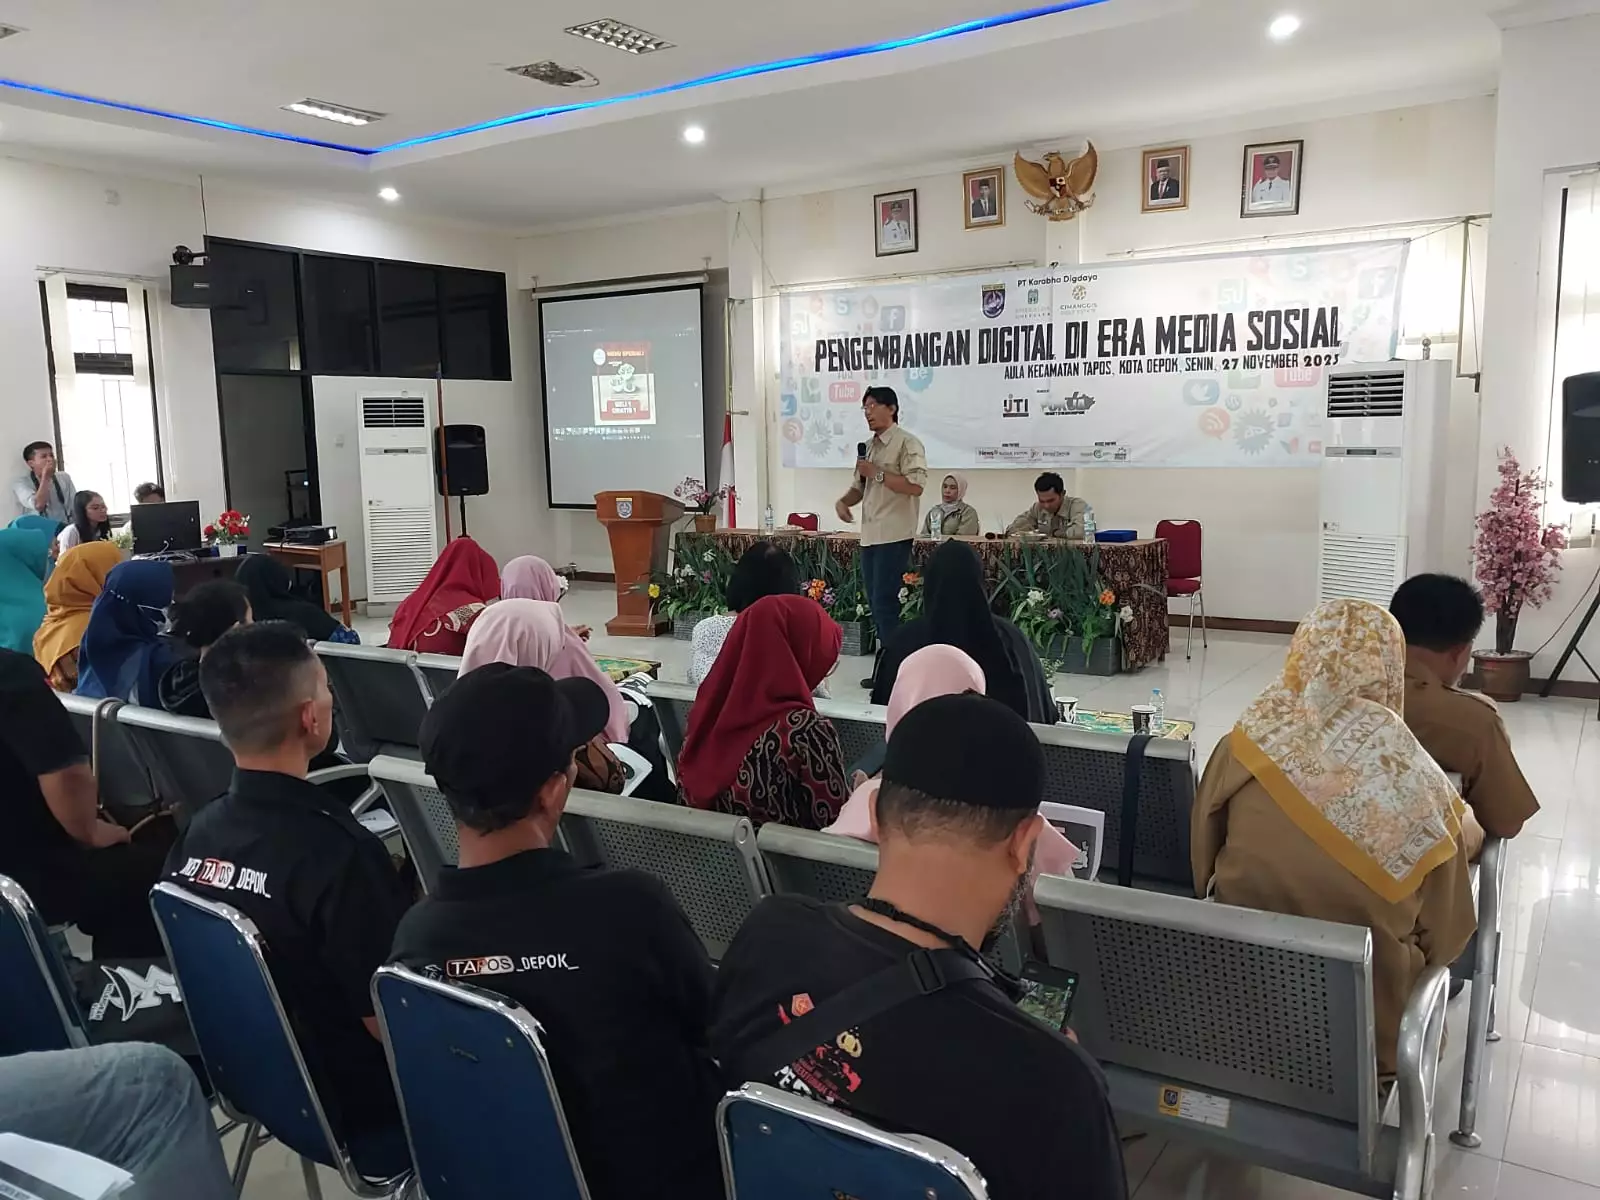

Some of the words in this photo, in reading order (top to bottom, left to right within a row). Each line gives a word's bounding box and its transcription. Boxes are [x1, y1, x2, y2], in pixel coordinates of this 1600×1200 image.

[1029, 277, 1061, 287] Karabha
[1063, 273, 1098, 284] Digdaya
[815, 329, 970, 373] PENGEMBANGAN
[977, 322, 1056, 364] DIGITAL
[1065, 321, 1089, 359] DI
[1097, 318, 1146, 358] ERA
[1155, 313, 1237, 355] MEDIA
[1247, 306, 1342, 351] SOSIAL
[1004, 365, 1025, 380] AULA
[1027, 362, 1079, 379] KECAMATAN
[1119, 359, 1143, 375] KOTA
[1222, 358, 1239, 370] 27
[1243, 353, 1299, 370] NOVEMBER
